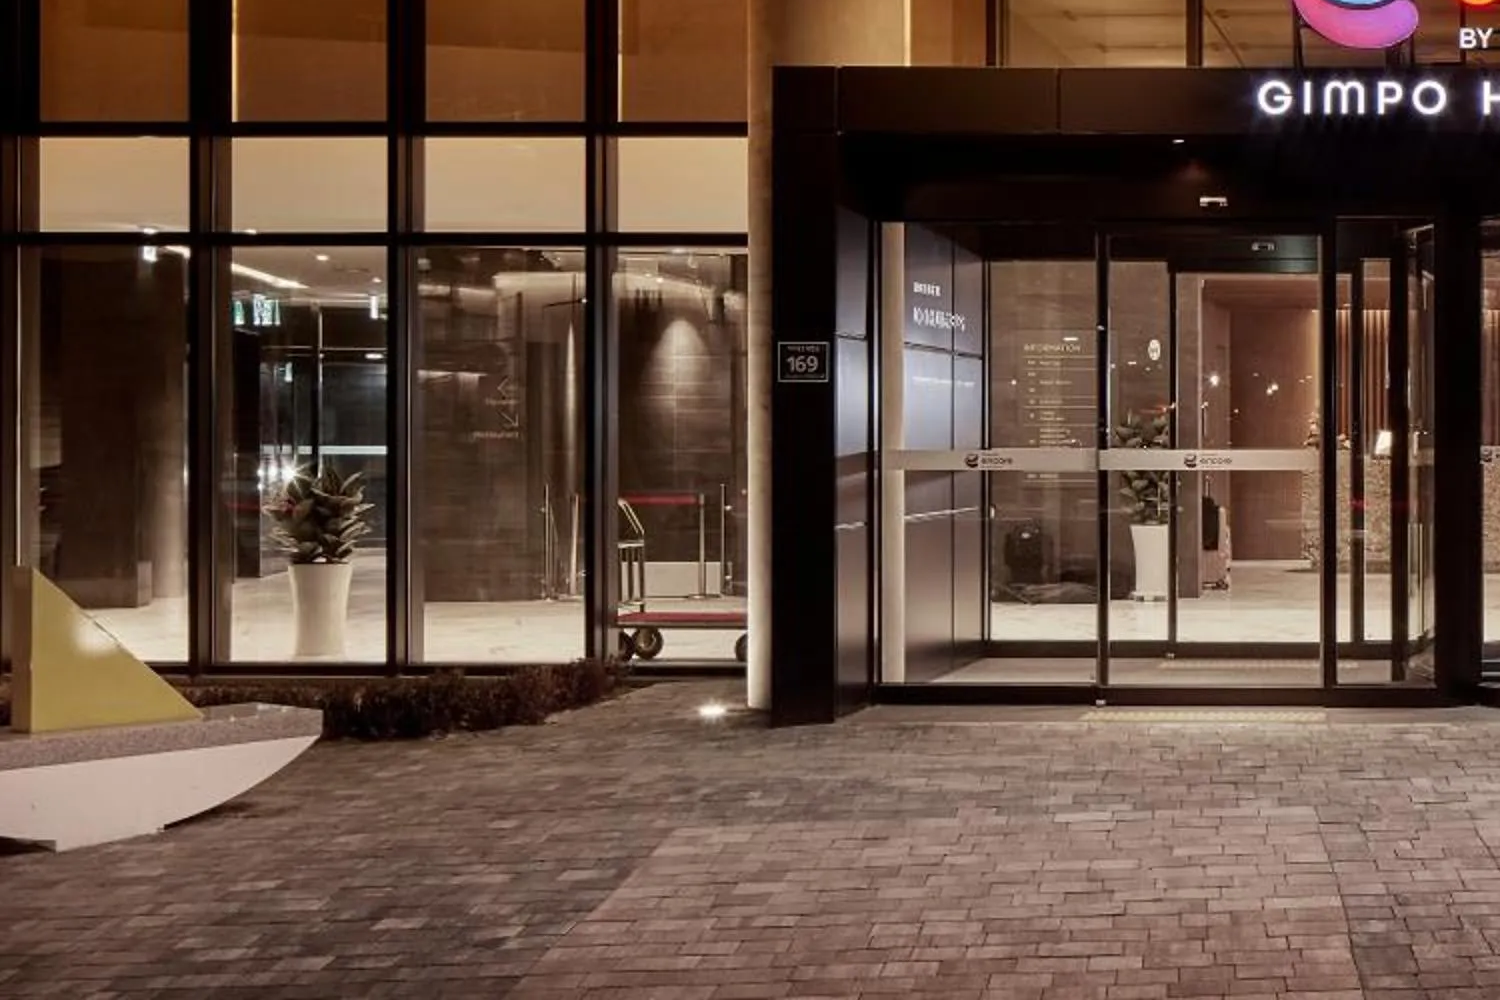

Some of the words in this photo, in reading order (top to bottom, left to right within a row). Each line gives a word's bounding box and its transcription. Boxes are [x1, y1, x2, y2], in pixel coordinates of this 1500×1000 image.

[1459, 27, 1494, 49] BY
[1257, 79, 1447, 115] GIMPO
[786, 355, 819, 373] 169
